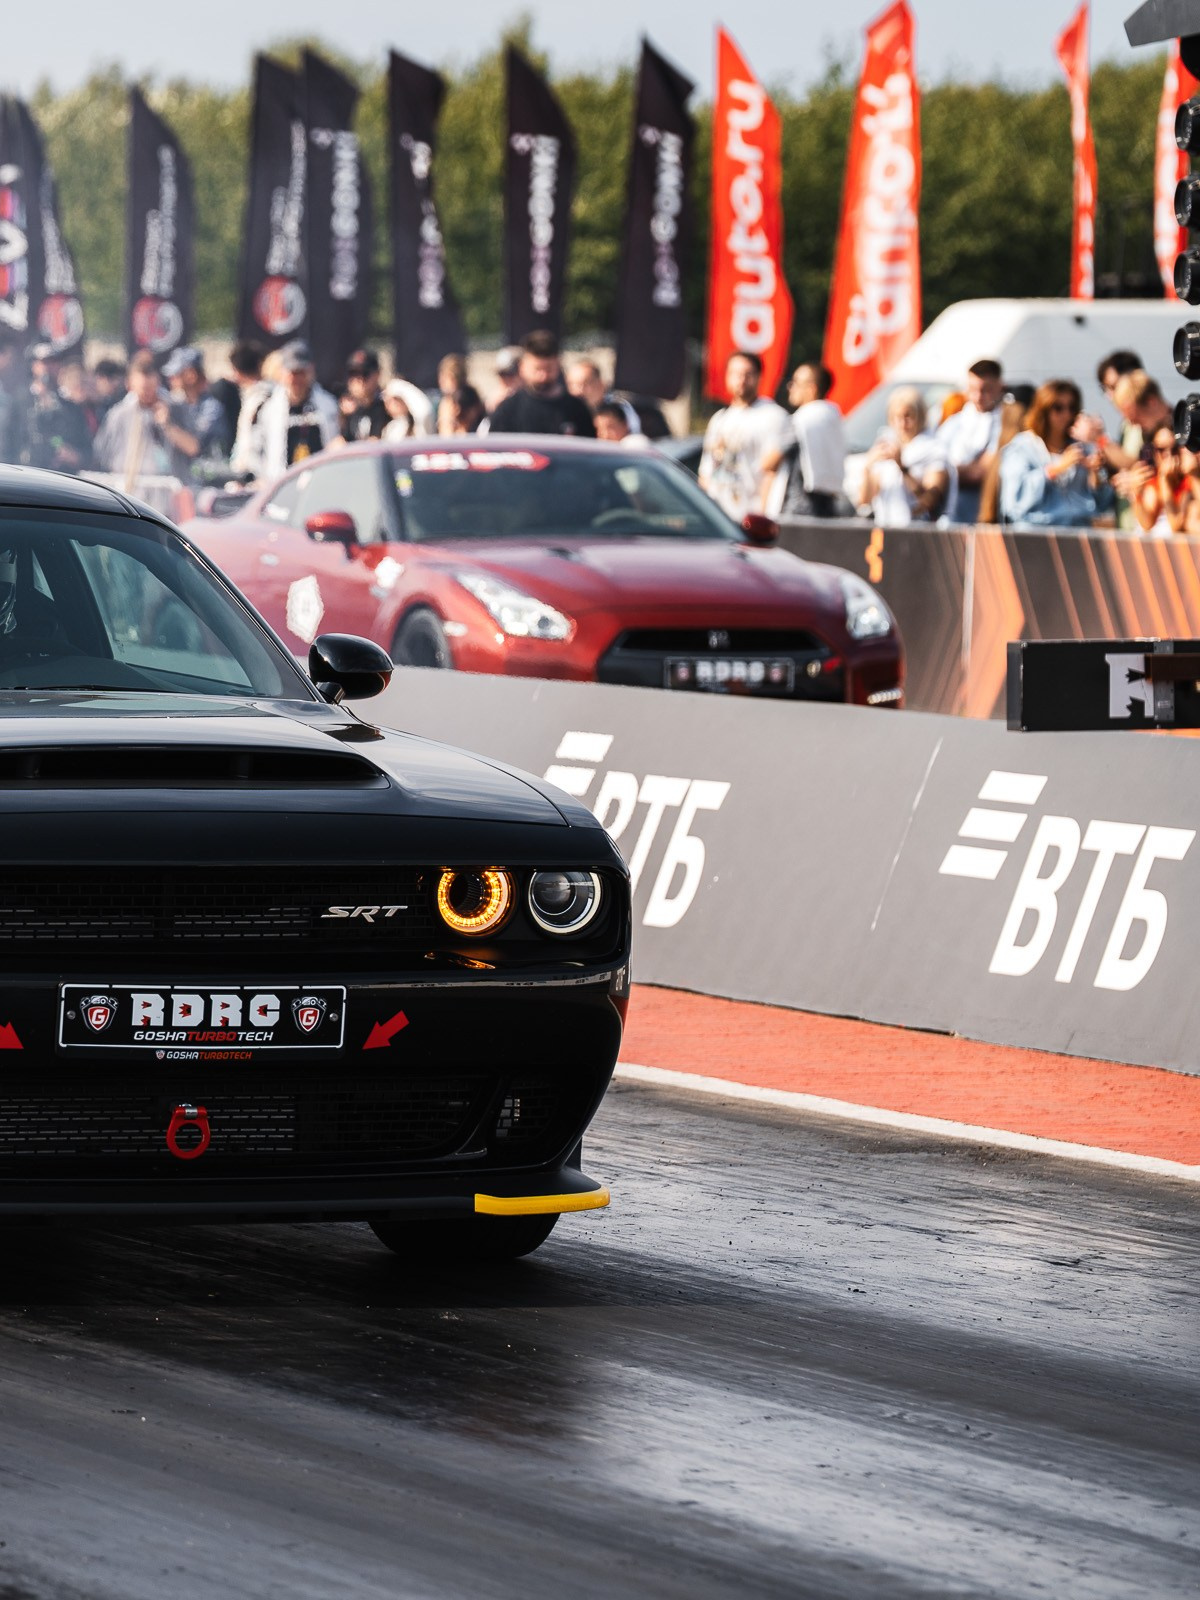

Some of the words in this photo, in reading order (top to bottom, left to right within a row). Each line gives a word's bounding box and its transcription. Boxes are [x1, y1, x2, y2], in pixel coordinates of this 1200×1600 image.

[726, 79, 777, 354] auto.ru
[988, 815, 1197, 992] ВТБ
[320, 905, 409, 923] SRT
[91, 1008, 106, 1025] G
[131, 993, 281, 1027] RDRC
[302, 1009, 316, 1026] G
[133, 1031, 275, 1042] GOSHATURBOTECH
[166, 1050, 253, 1060] GOSHATURBOTECH
